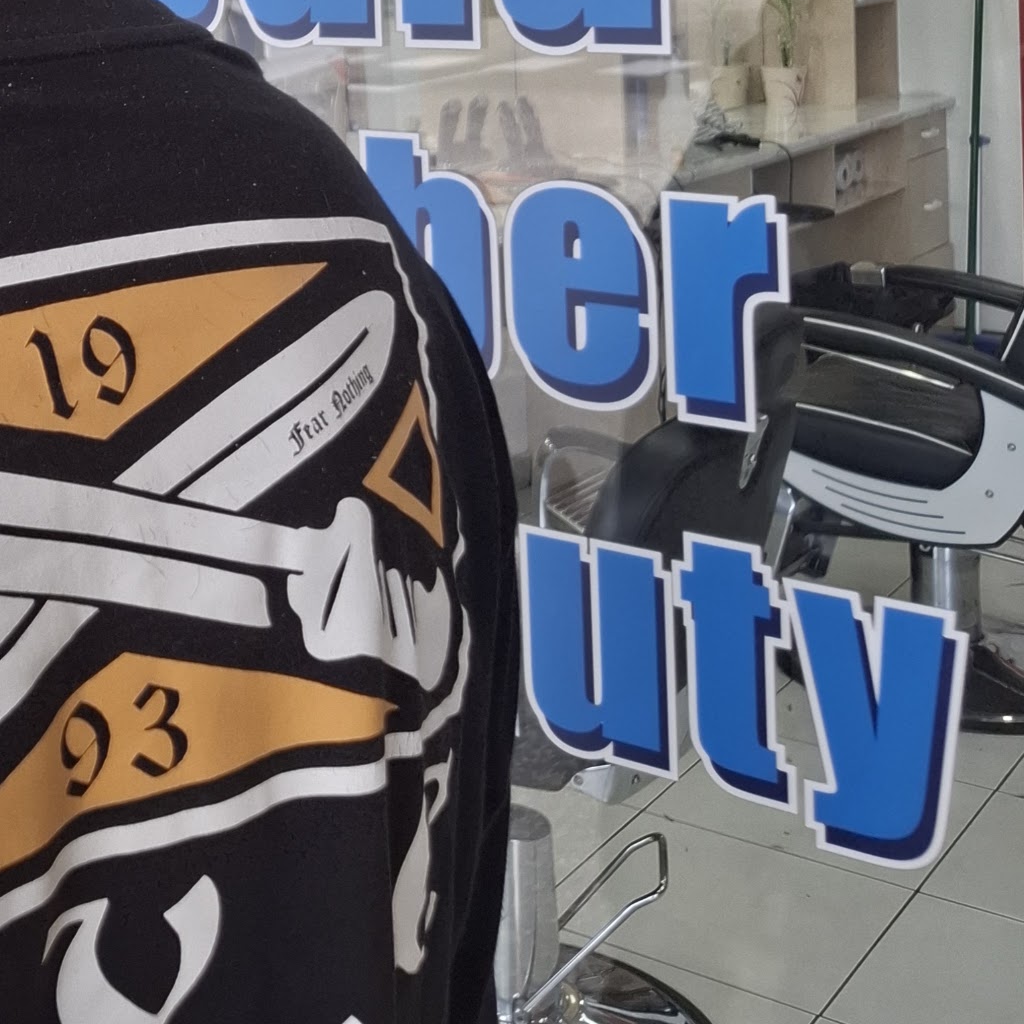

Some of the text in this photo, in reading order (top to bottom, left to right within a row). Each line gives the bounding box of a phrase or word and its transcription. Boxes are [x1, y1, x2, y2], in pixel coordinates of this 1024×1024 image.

[24, 314, 137, 419] 19
[288, 363, 374, 456] Fear Nothing
[60, 682, 189, 797] 93
